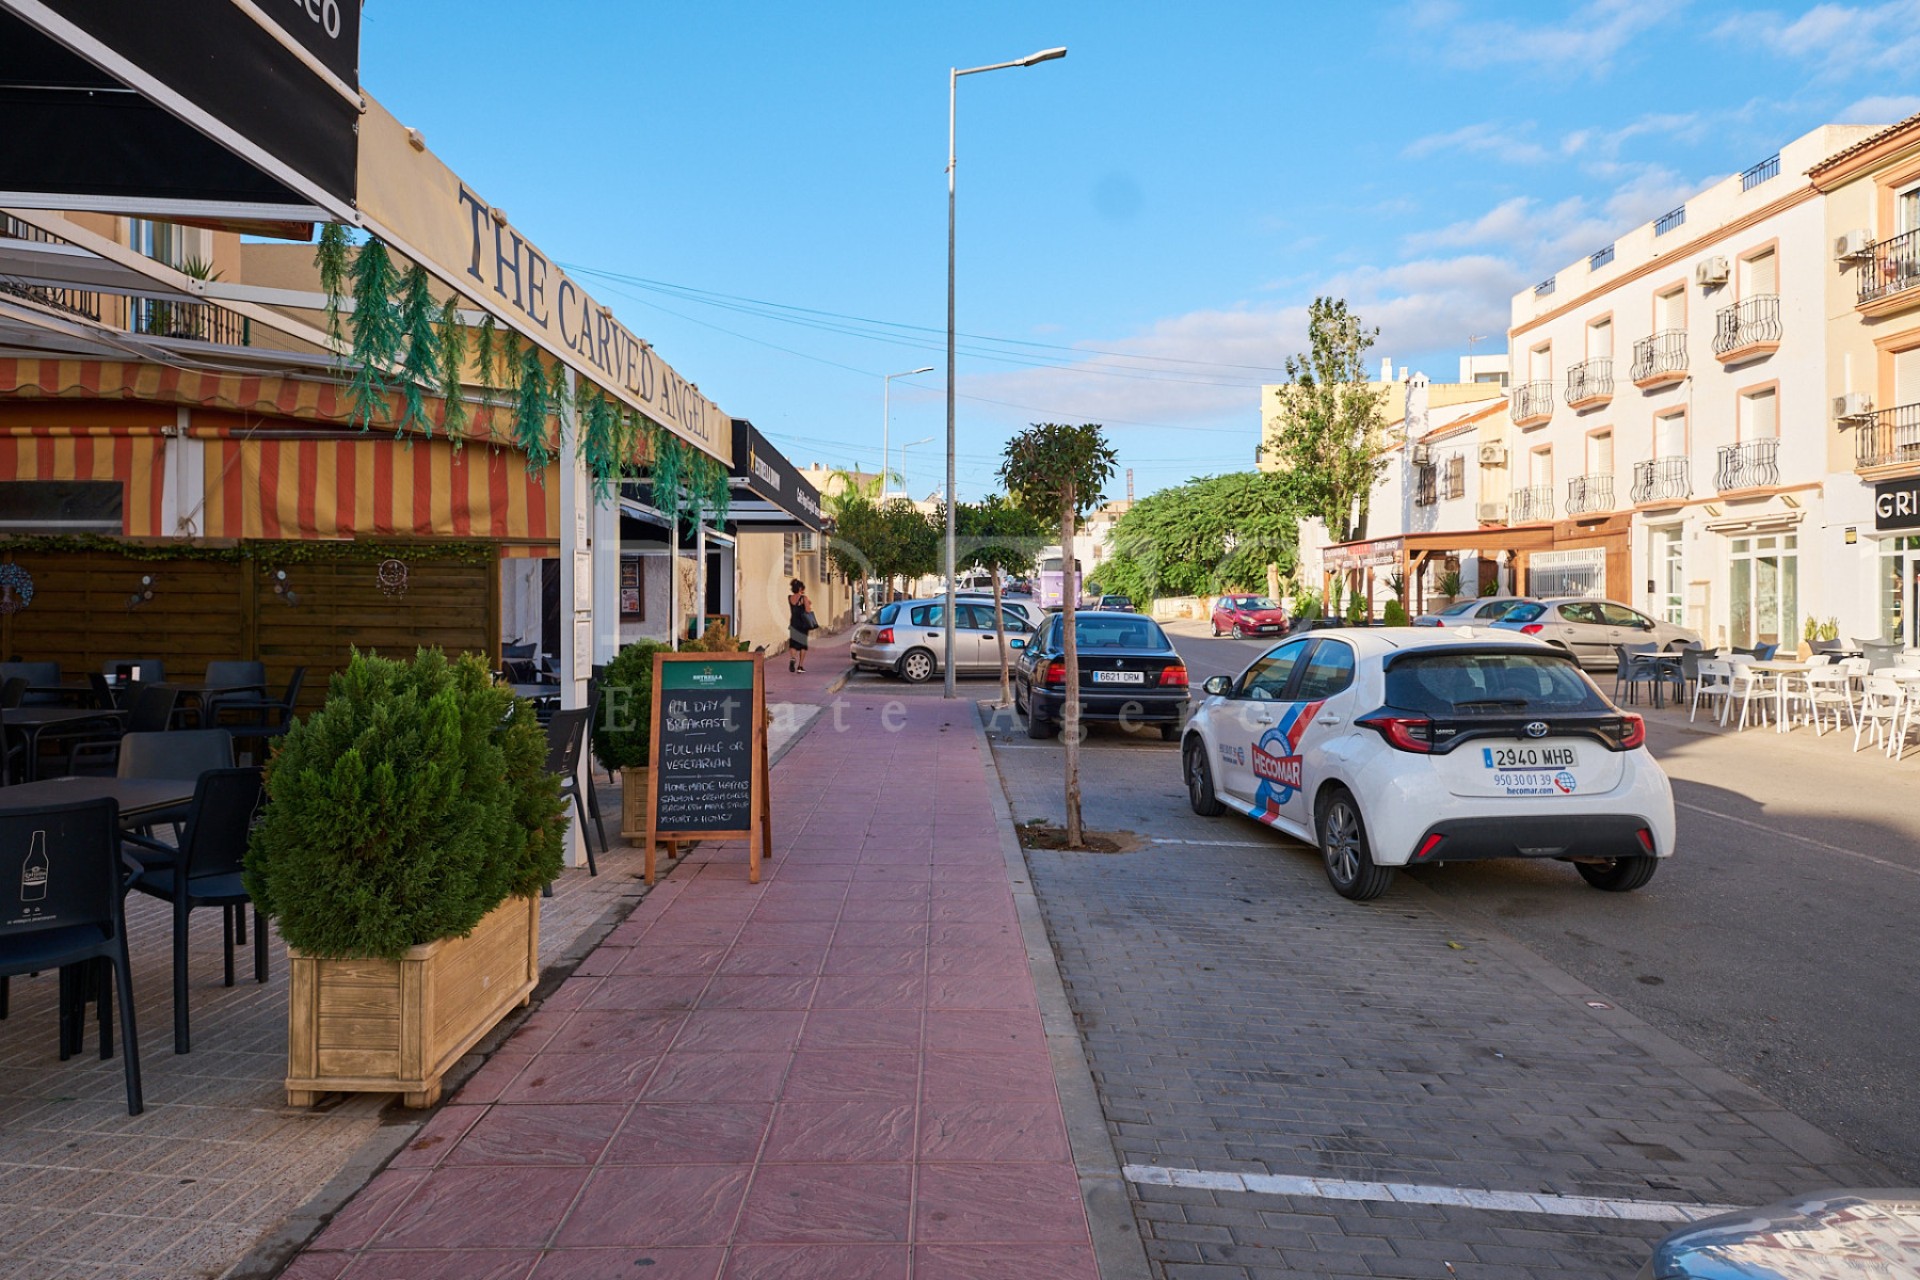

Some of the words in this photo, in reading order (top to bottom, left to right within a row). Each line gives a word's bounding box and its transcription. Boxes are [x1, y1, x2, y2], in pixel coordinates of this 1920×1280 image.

[459, 183, 548, 329] THE
[558, 280, 654, 403] CARVED
[660, 372, 709, 441] ANGEL
[1100, 673, 1120, 681] 6621
[1123, 673, 1140, 682] DRM
[669, 700, 690, 714] ALL
[694, 700, 718, 712] DAY
[666, 718, 729, 731] BREAKFAST
[695, 741, 724, 754] HALF
[729, 741, 744, 751] OR
[666, 757, 732, 770] VEGETARIAN
[1496, 749, 1537, 766] 2940
[1542, 749, 1574, 765] MHB
[1253, 750, 1300, 786] HECOMAR
[664, 781, 715, 792] HOMEMADE
[1494, 775, 1511, 786] 950
[1514, 775, 1525, 785] 30
[1527, 775, 1538, 785] 01
[1541, 775, 1552, 785] 39
[1507, 787, 1553, 795] hecomar.com
[660, 795, 694, 803] SALMON
